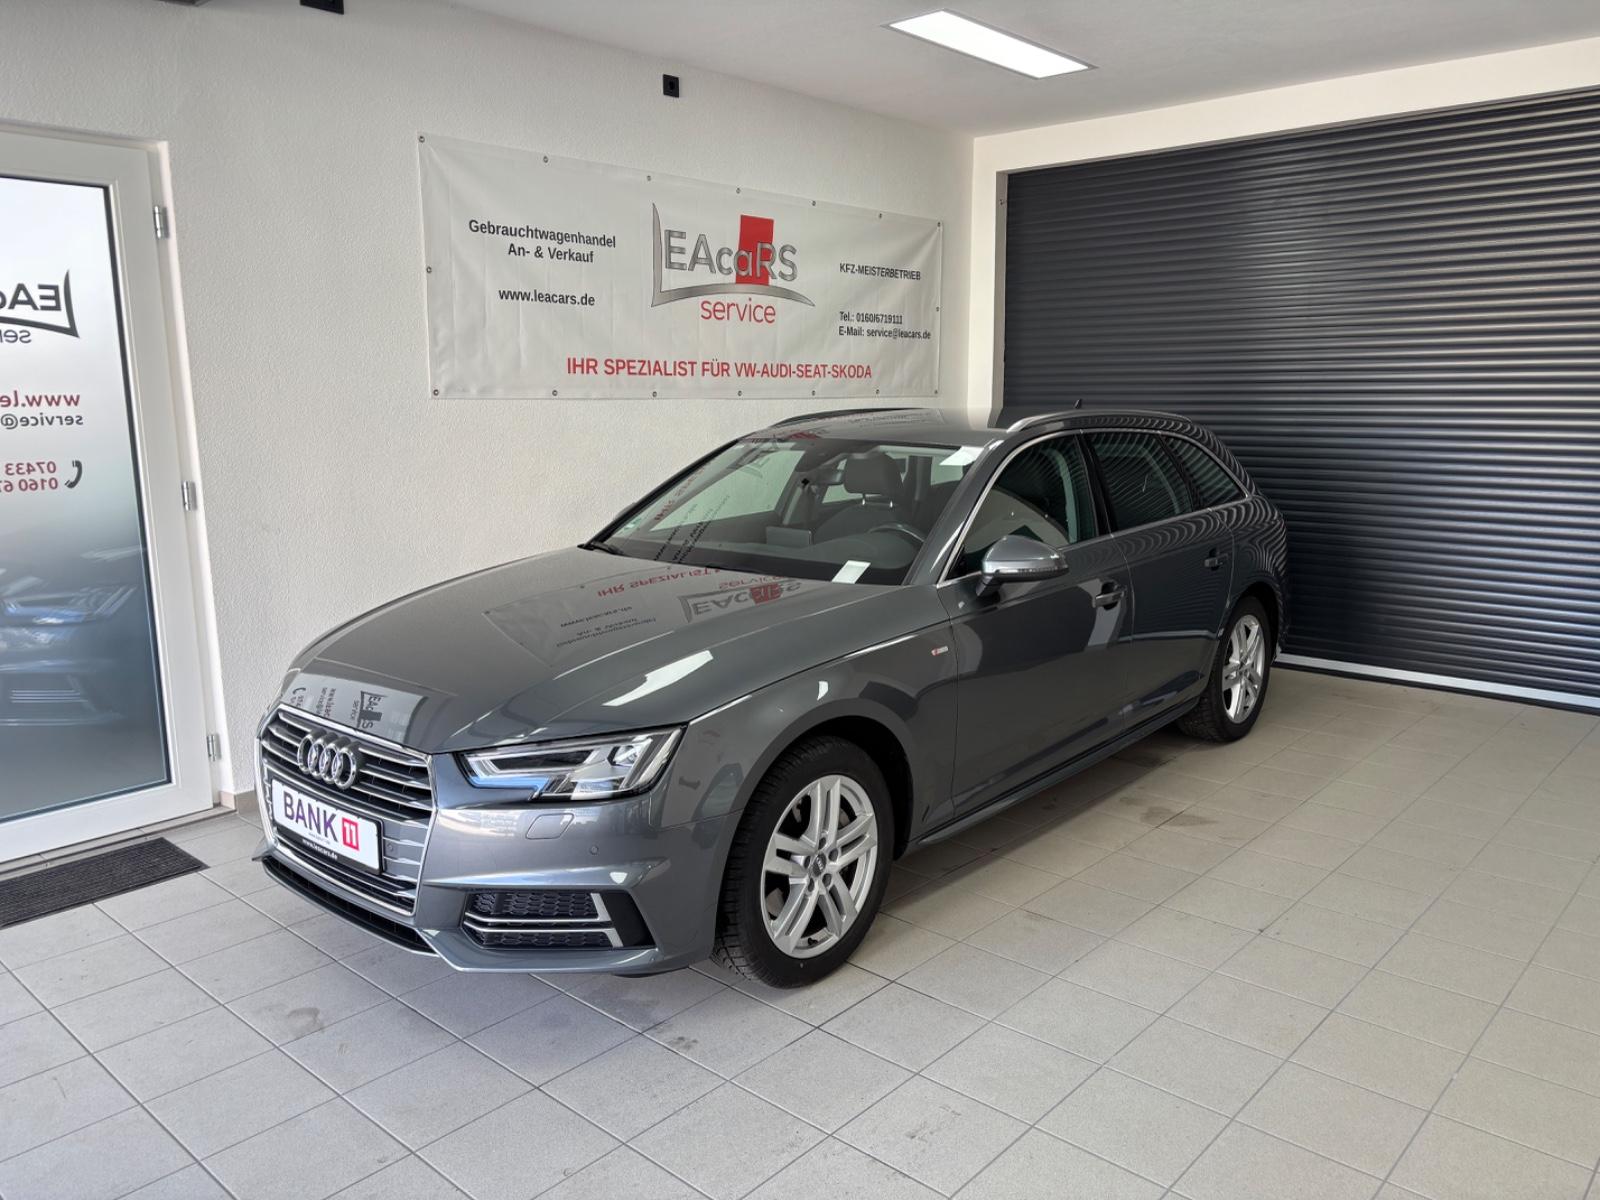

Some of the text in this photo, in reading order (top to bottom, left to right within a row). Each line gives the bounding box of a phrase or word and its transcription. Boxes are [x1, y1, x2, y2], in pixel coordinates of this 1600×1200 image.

[468, 219, 617, 248] Gebrauchtwagenhandel
[508, 243, 595, 263] An- & Verkauf
[839, 263, 922, 281] KFZ-MEISTERBETRIEB
[498, 289, 596, 306] www.leacars.de
[700, 296, 776, 324] service
[839, 311, 855, 322] Tel.:
[838, 326, 931, 340] E-Mail: service@leacars.de
[566, 357, 873, 380] IHR SPEZIALIST FÜR VW-AUDI-SEAT-SKODA
[283, 790, 358, 849] BANK 11
